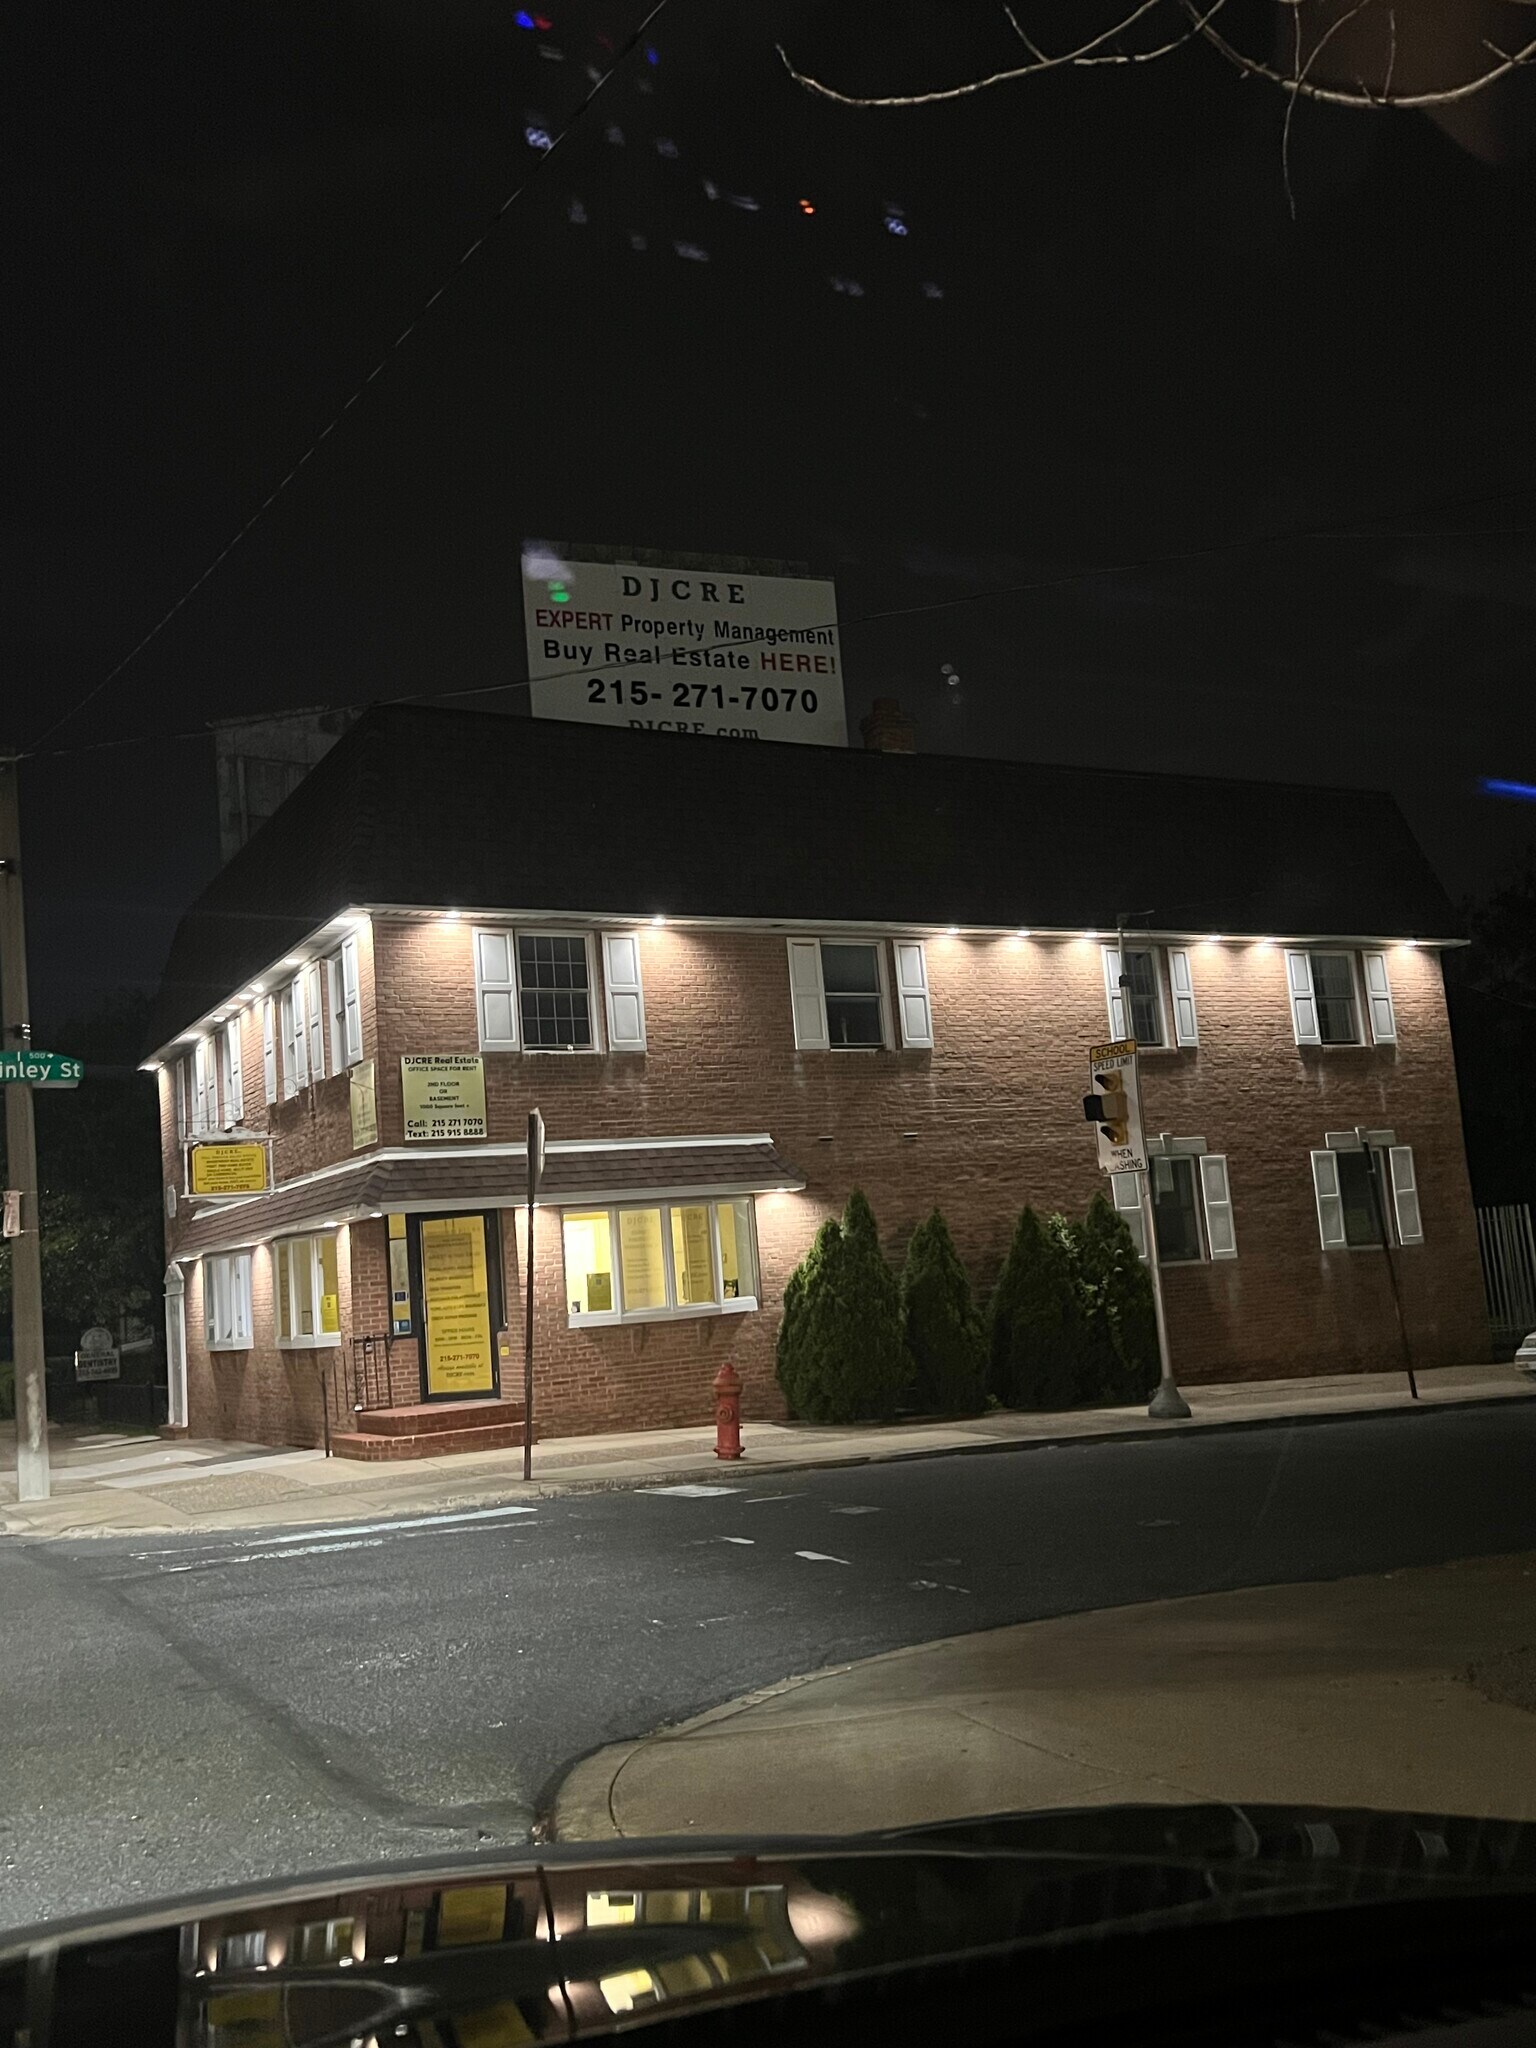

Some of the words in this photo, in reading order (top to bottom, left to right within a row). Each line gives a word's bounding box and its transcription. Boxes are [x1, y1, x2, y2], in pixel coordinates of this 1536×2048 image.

[622, 576, 745, 604] DJCRE
[535, 608, 613, 631] EXPERT
[622, 614, 705, 641] Property
[714, 620, 835, 646] Management
[543, 639, 593, 665] Buy
[605, 643, 661, 664] Real
[673, 648, 750, 669] Estate
[760, 652, 837, 675] HERE!
[587, 678, 662, 705] 215-
[673, 682, 818, 713] 271-7070
[1095, 1043, 1131, 1059] SCHOOL
[405, 1056, 433, 1065] DJCRE
[435, 1056, 453, 1064] Real
[455, 1056, 479, 1064] Estate
[1093, 1059, 1115, 1072] SPEED
[1116, 1055, 1133, 1068] LIMIT
[60, 1062, 81, 1078] St
[407, 1120, 428, 1128] Call:
[432, 1119, 446, 1127] 215
[463, 1118, 483, 1126] 7070
[407, 1130, 429, 1138] Text:
[431, 1129, 445, 1137] 215
[447, 1128, 462, 1136] 915
[463, 1128, 484, 1136] 8888
[1110, 1148, 1134, 1159] WHEN
